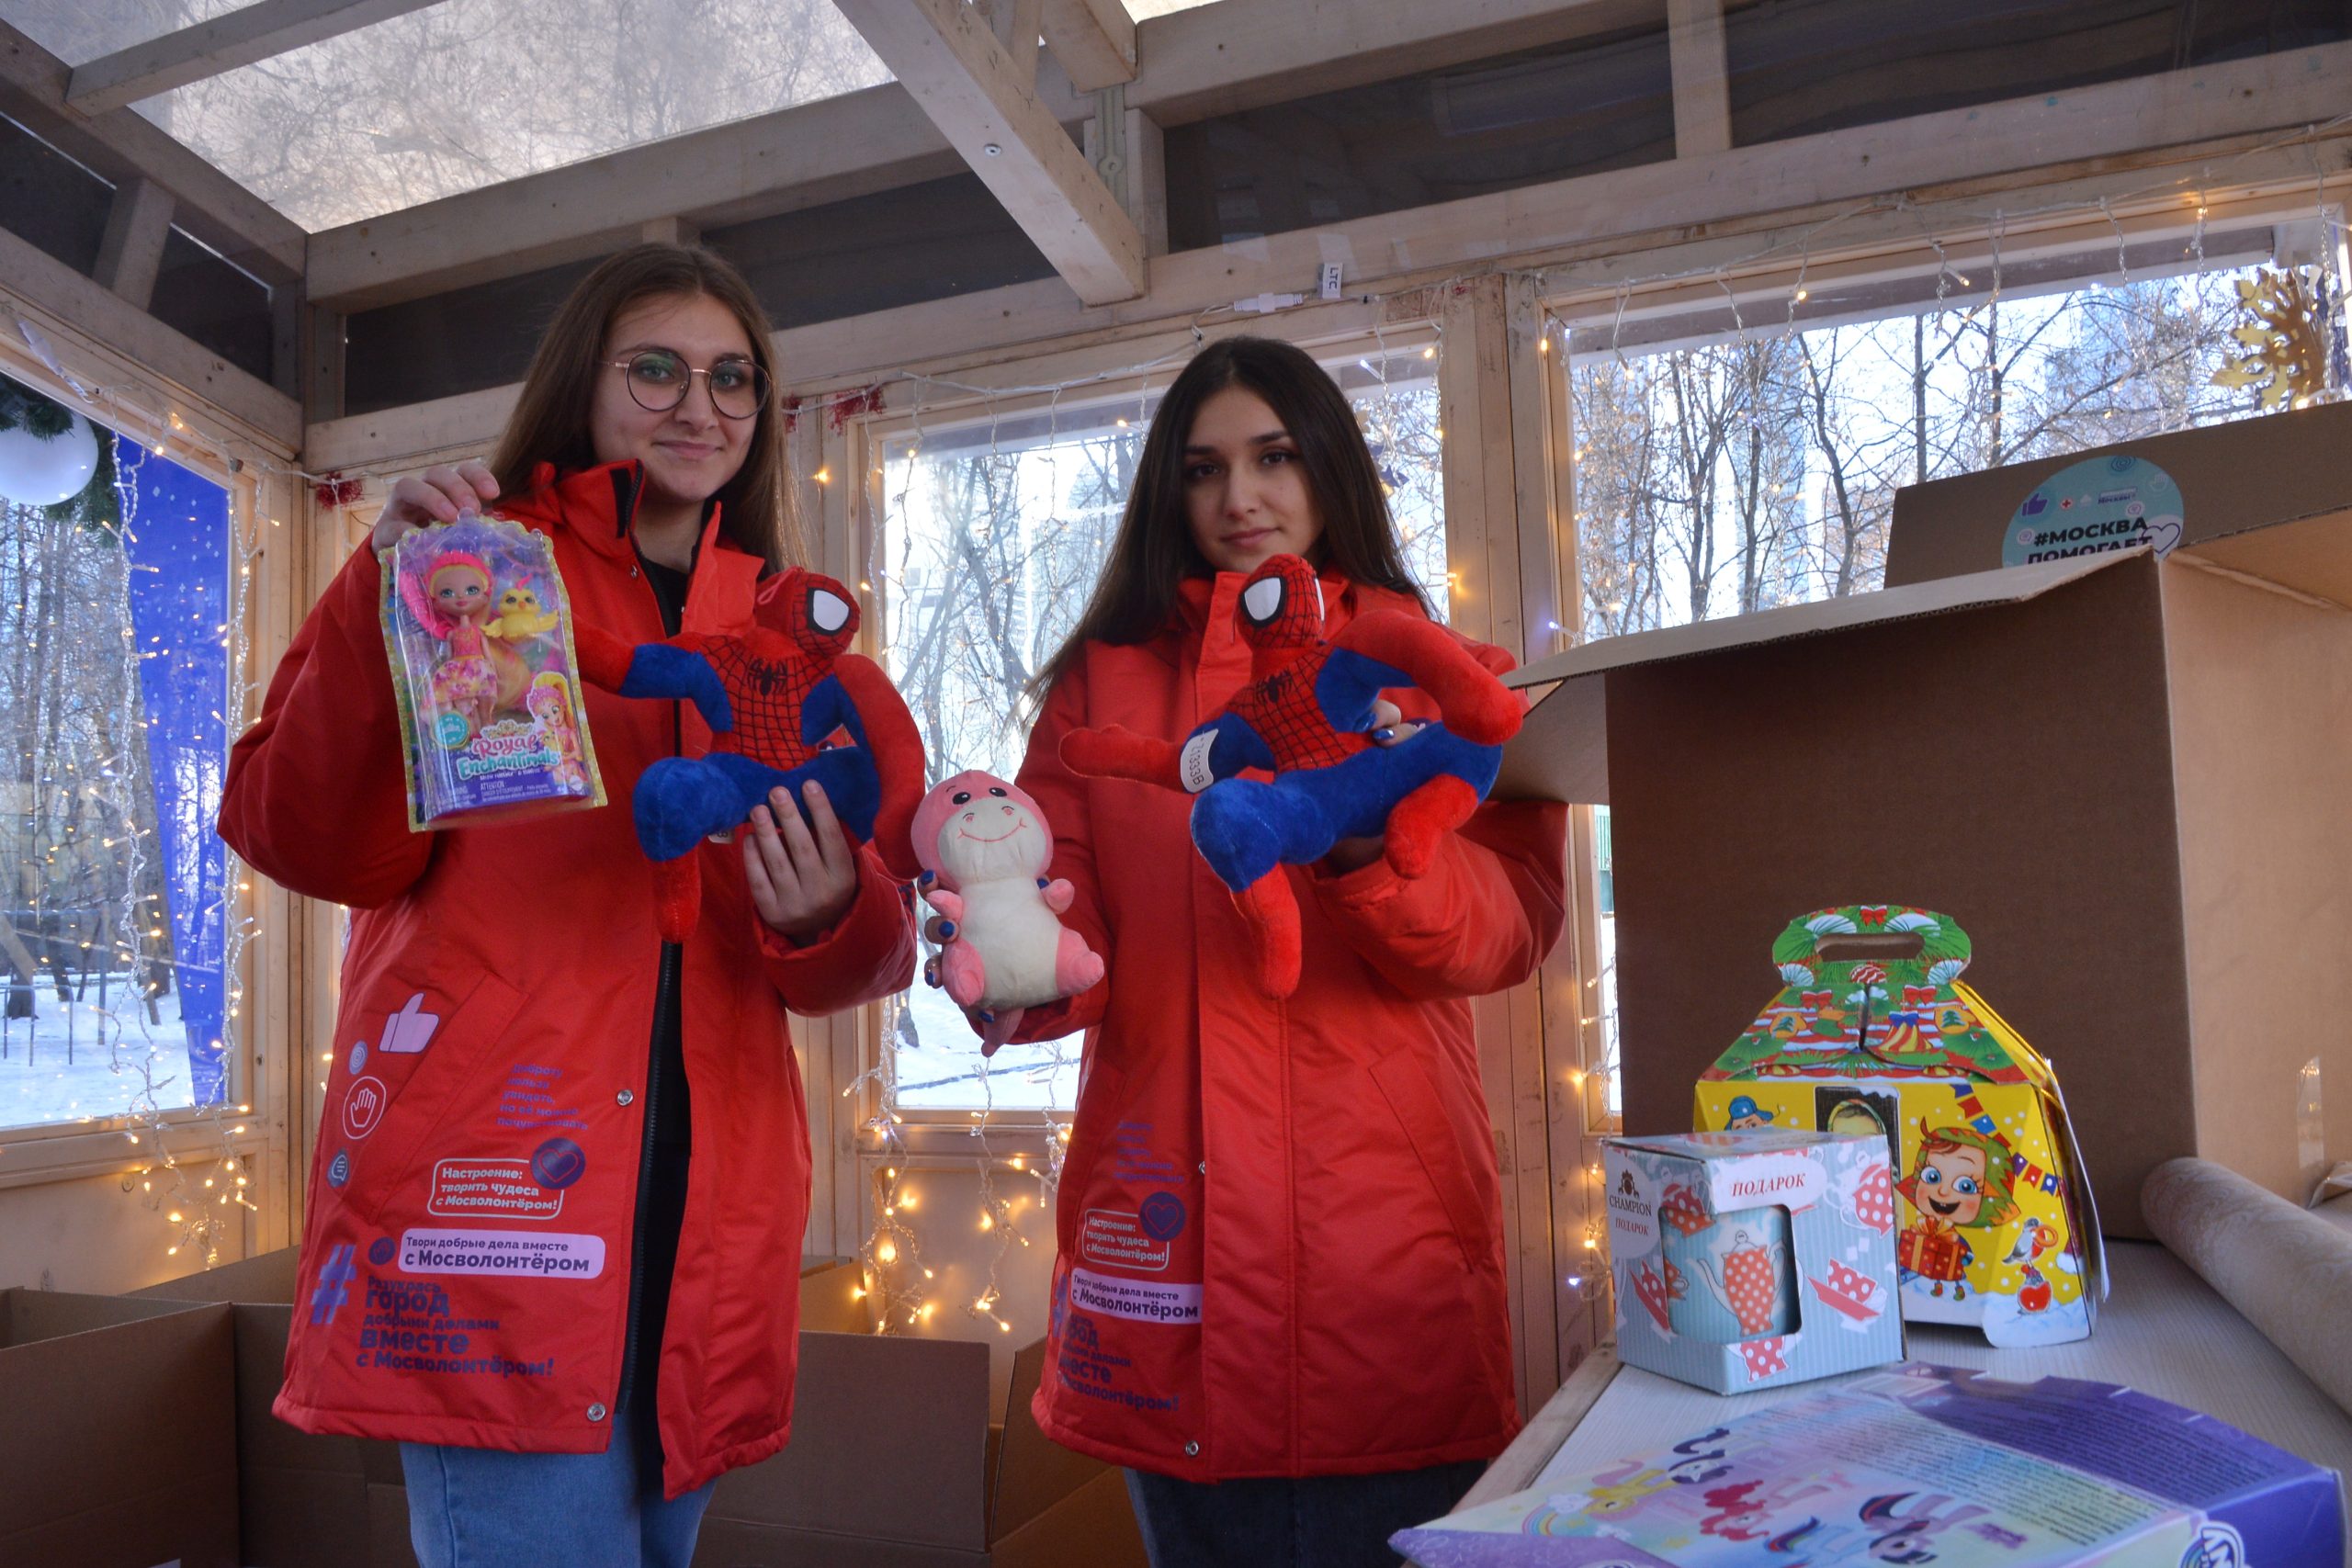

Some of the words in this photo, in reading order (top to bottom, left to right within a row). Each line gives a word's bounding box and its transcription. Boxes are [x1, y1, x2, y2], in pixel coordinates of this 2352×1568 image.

[1329, 267, 1339, 289] LTC
[2033, 516, 2148, 547] #МОСКВА
[473, 736, 537, 756] Royal
[442, 1167, 523, 1179] Настроение:
[440, 1183, 488, 1193] творить
[491, 1182, 539, 1197] чудеса
[1731, 1173, 1806, 1197] ПОДАРОК
[435, 1198, 444, 1206] с
[445, 1195, 559, 1212] Мосволонтёром!
[1609, 1196, 1652, 1216] CHAMPION
[1089, 1216, 1136, 1233] Настроение:
[1615, 1216, 1649, 1235] ПОДАРОК
[406, 1236, 436, 1247] Твори
[438, 1237, 485, 1249] добрые
[488, 1239, 519, 1250] дела
[522, 1241, 569, 1252] вместе
[1117, 1235, 1149, 1247] чудеса
[404, 1253, 414, 1266] с
[418, 1249, 590, 1274] Мосволонтёром
[365, 1290, 450, 1317] город
[1080, 1288, 1198, 1321] Мосволонтёром
[1119, 1288, 1141, 1298] дела
[1143, 1291, 1179, 1301] вместе
[359, 1328, 470, 1355] вместе
[374, 1351, 556, 1378] Мосволонтёром!
